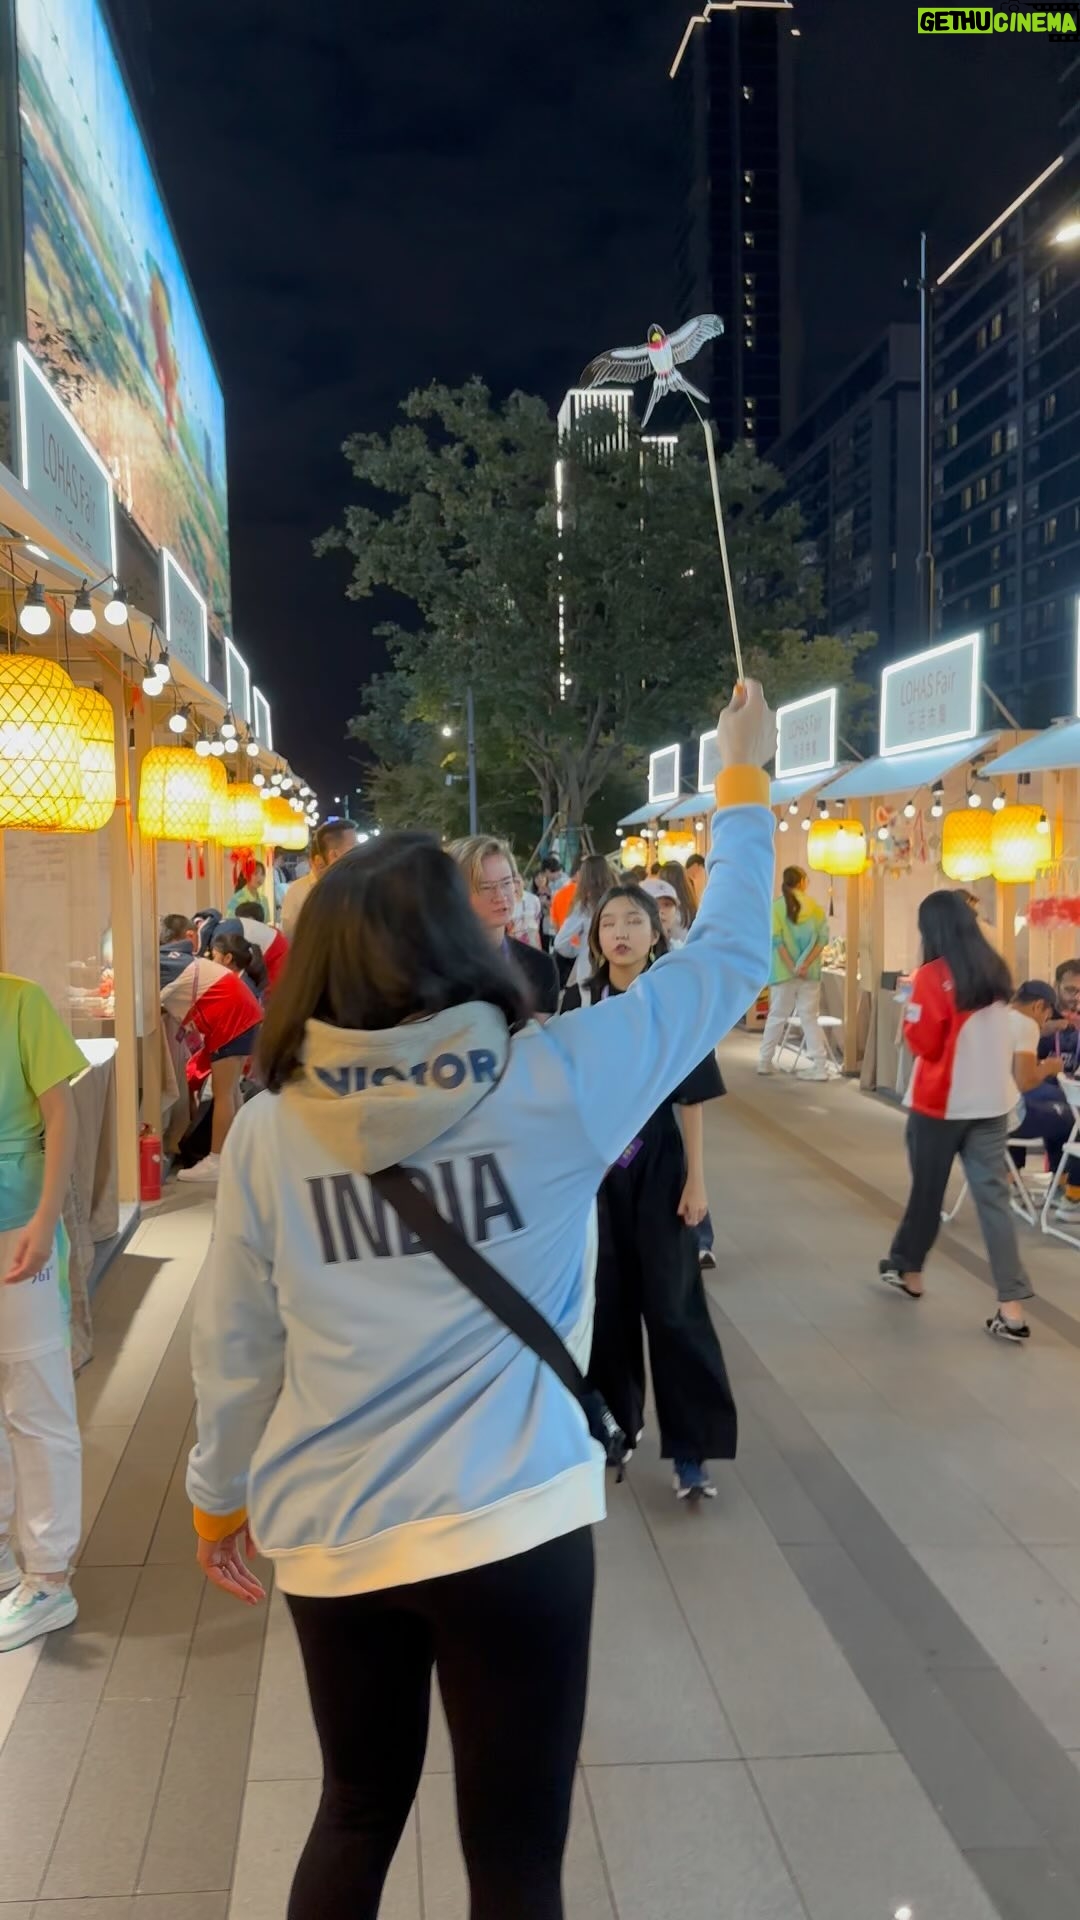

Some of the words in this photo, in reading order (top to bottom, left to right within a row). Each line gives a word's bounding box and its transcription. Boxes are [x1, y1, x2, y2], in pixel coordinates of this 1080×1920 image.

[41, 423, 79, 509] LOHAS
[80, 474, 96, 529] Fair
[901, 671, 933, 707] LOHAS
[935, 665, 956, 696] Fair
